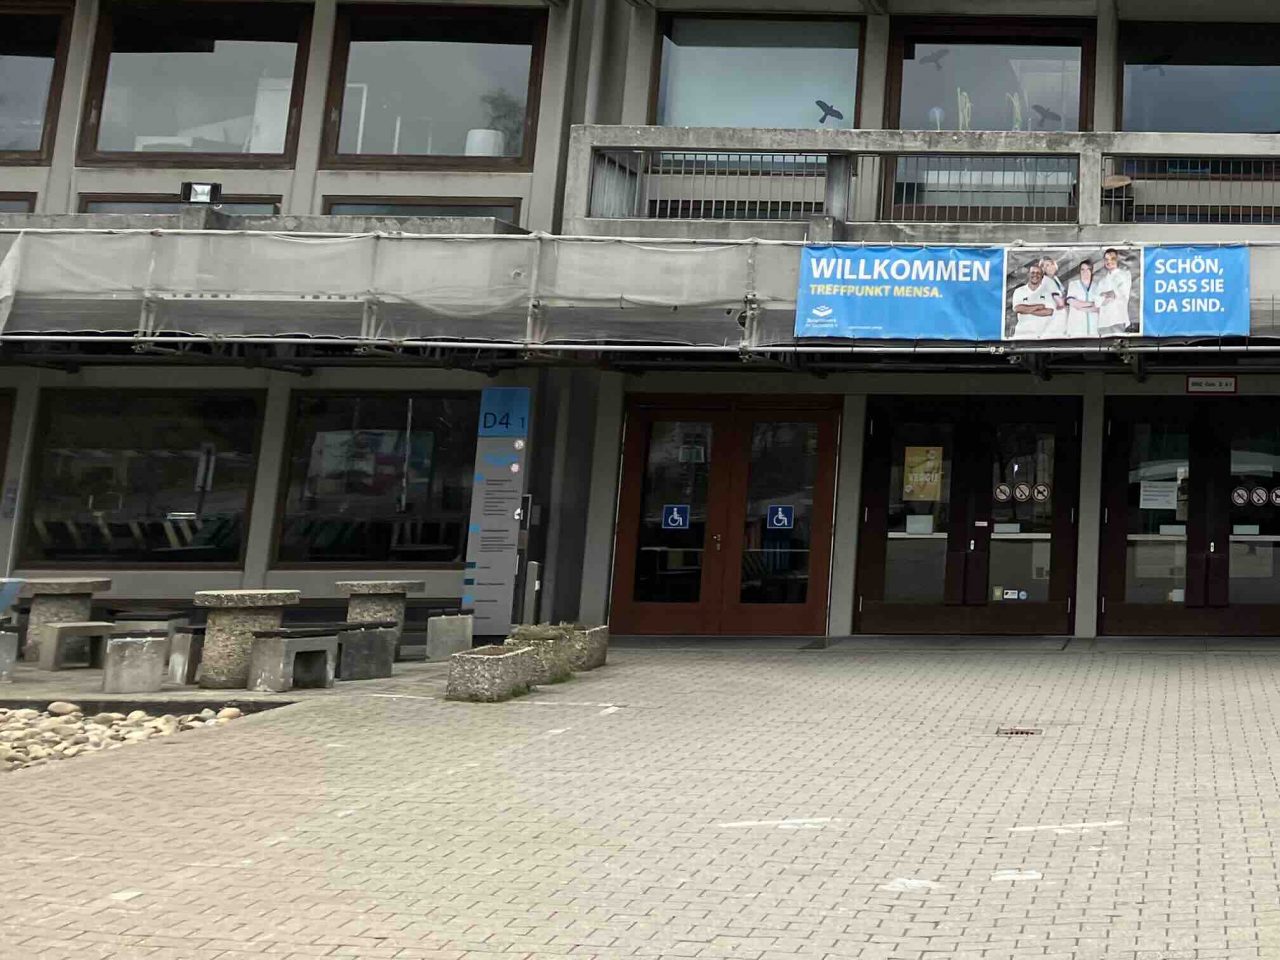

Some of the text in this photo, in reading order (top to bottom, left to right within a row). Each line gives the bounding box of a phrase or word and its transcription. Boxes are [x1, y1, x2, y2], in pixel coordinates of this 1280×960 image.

[810, 257, 991, 282] WILLKOMMEN
[1154, 255, 1224, 275] SCHÖN,
[809, 284, 943, 298] TREFFPUNKT MENSA.
[1154, 279, 1225, 293] DASS SIE
[1154, 298, 1225, 313] DA SIND.
[483, 412, 511, 429] D4
